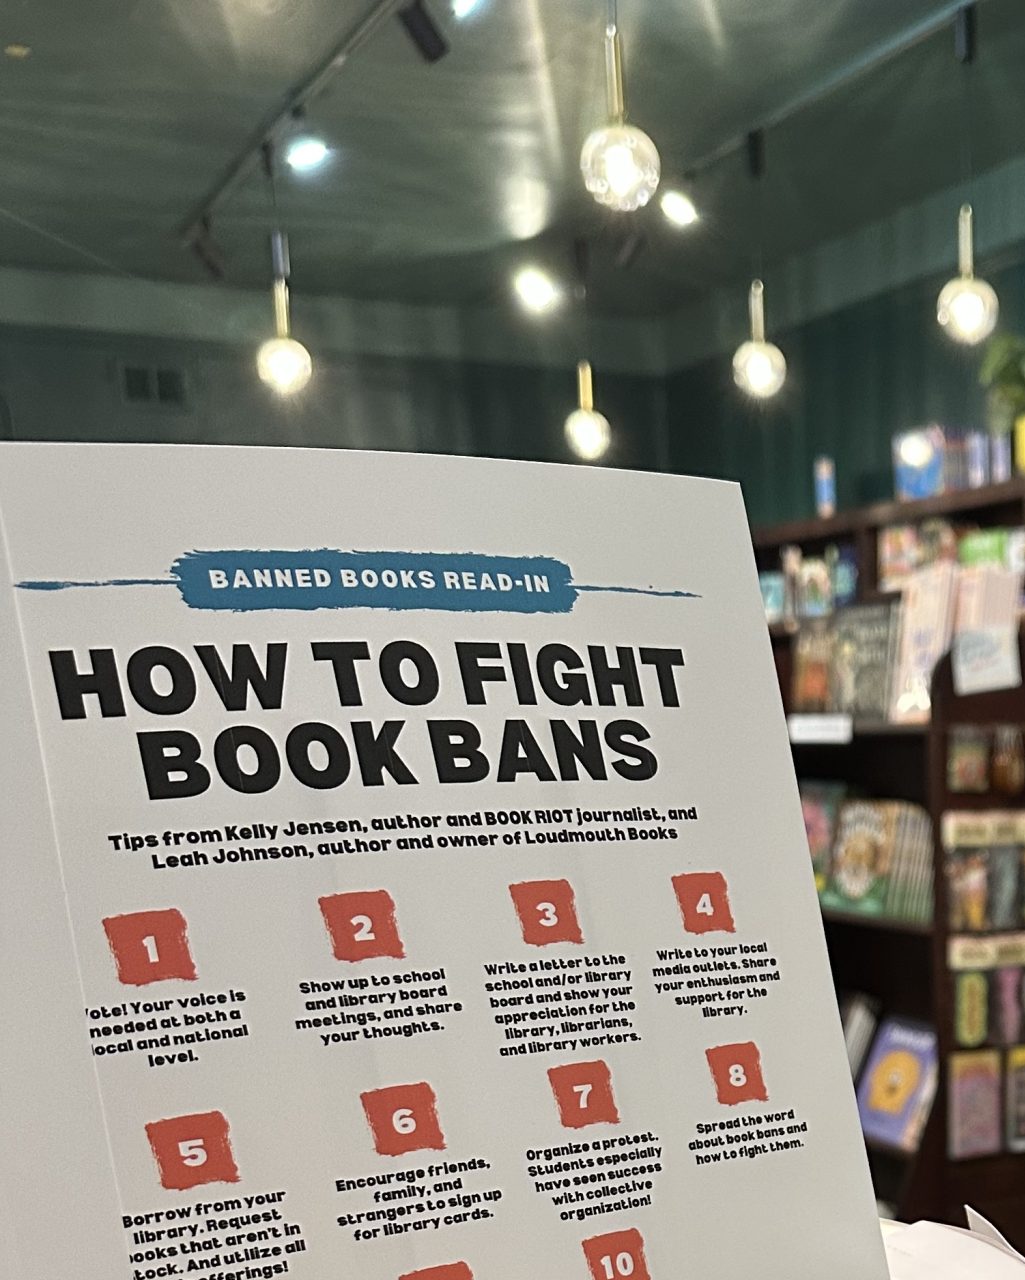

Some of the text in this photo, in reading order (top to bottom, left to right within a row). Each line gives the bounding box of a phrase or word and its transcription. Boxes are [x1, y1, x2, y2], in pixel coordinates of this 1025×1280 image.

[209, 568, 550, 593] BANNED BOOKS READ-IN
[48, 640, 685, 721] HOW TO FIGHT
[135, 719, 658, 801] BOOK BANS
[107, 806, 698, 852] Tips from Kelly Jensen, author and BOOK RIOT journalist, and
[151, 826, 678, 870] Leah Johnson, author and owner of Loudmouth Books
[536, 902, 558, 927] 3
[696, 893, 714, 916] 4
[351, 915, 376, 941] 2
[142, 936, 159, 962] 1
[656, 942, 768, 961] Write to your local
[483, 954, 626, 976] Write a letter to the
[652, 957, 777, 977] media outlets. Share
[299, 968, 446, 994] Show up to school
[484, 970, 632, 992] school and/or library
[305, 984, 448, 1011] and library board
[89, 1009, 242, 1039] needed at both a
[294, 1002, 463, 1030] meetings, and share
[319, 1021, 445, 1047] your thoughts.
[147, 1049, 199, 1068] level.
[729, 1064, 747, 1087] 8
[573, 1084, 592, 1109] 7
[392, 1109, 416, 1134] 6
[696, 1109, 795, 1135] Spread the word
[178, 1139, 207, 1167] 5
[526, 1131, 659, 1161] Organize a protest.
[695, 1139, 802, 1165] how to fight them.
[335, 1158, 491, 1192] Encourage friends,
[527, 1146, 662, 1178] Students especially
[373, 1177, 463, 1203] family, and
[121, 1191, 286, 1229] Borrow from your
[133, 1208, 283, 1245] library. Request
[600, 1252, 634, 1280] 10
